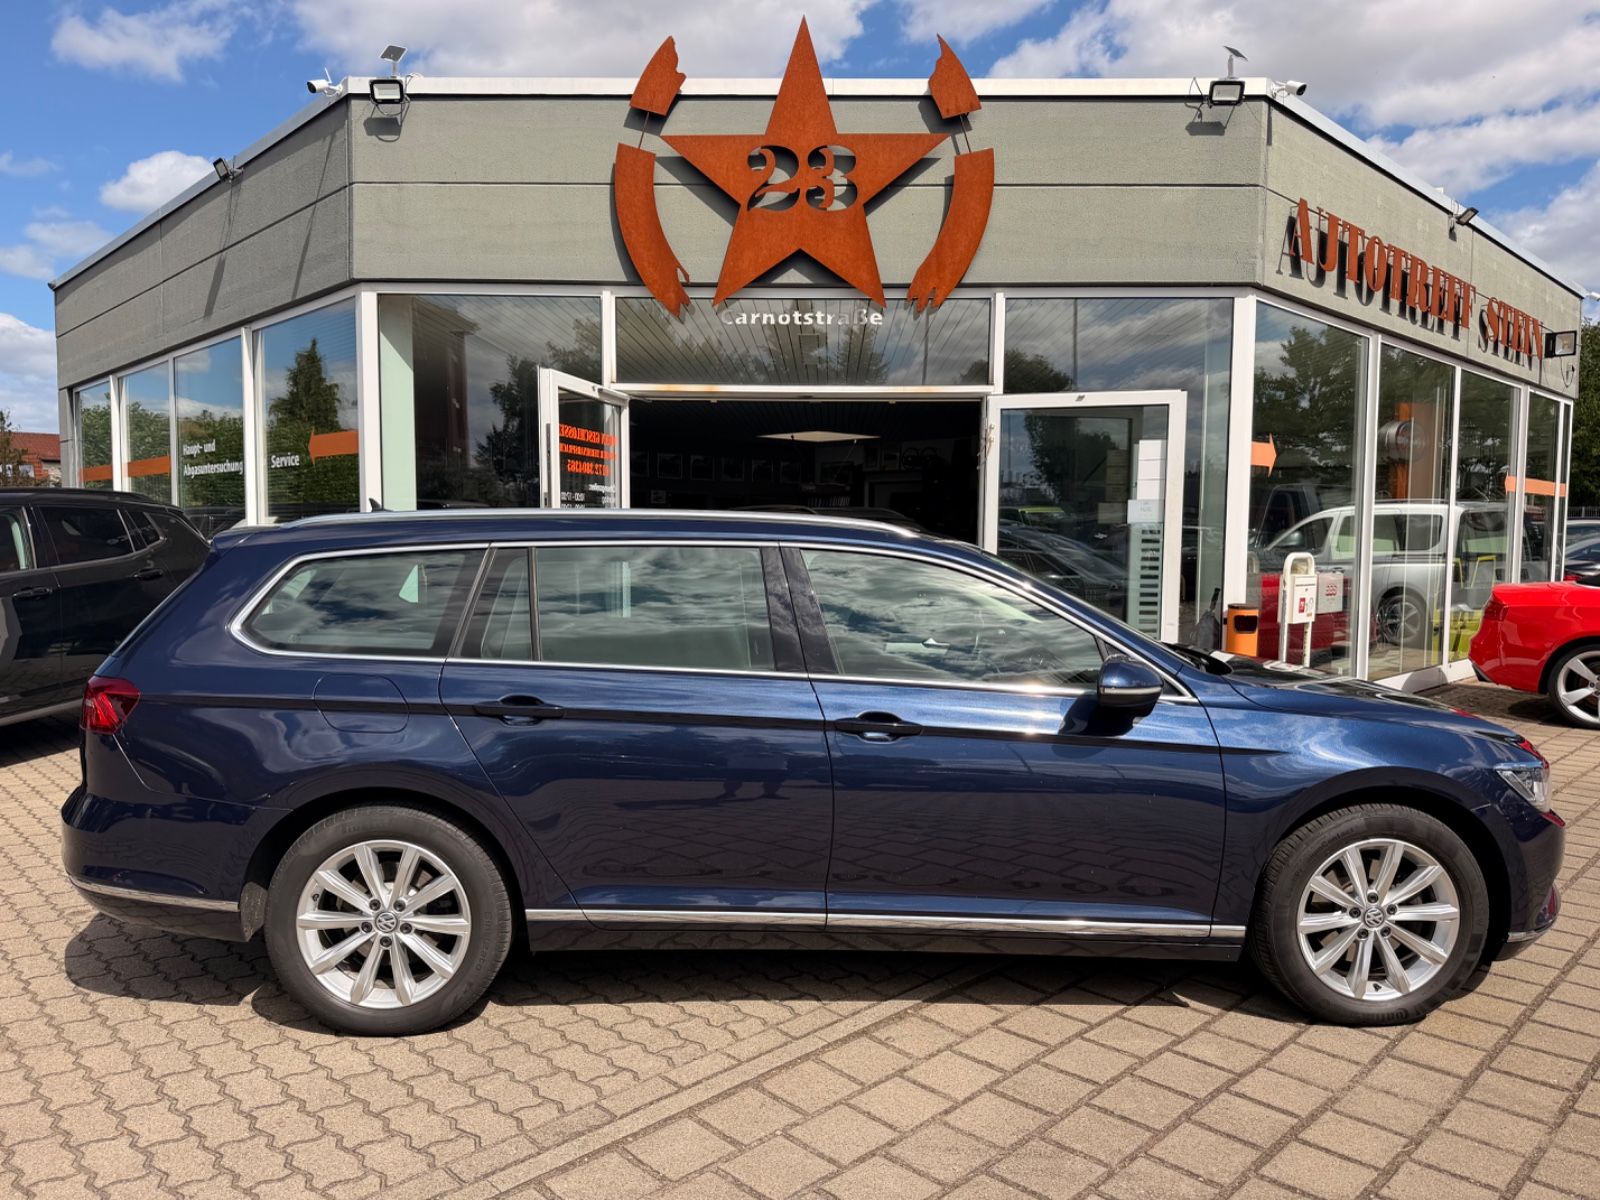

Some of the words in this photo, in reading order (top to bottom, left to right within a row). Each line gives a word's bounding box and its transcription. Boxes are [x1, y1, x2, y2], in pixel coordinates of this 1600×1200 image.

[747, 145, 858, 212] 23
[720, 308, 883, 326] Carnotstraße
[1486, 297, 1544, 361] STEIN
[183, 441, 203, 458] Haupt-
[203, 439, 216, 453] und
[183, 459, 244, 479] Abgasuntersuchung
[270, 452, 300, 469] Service
